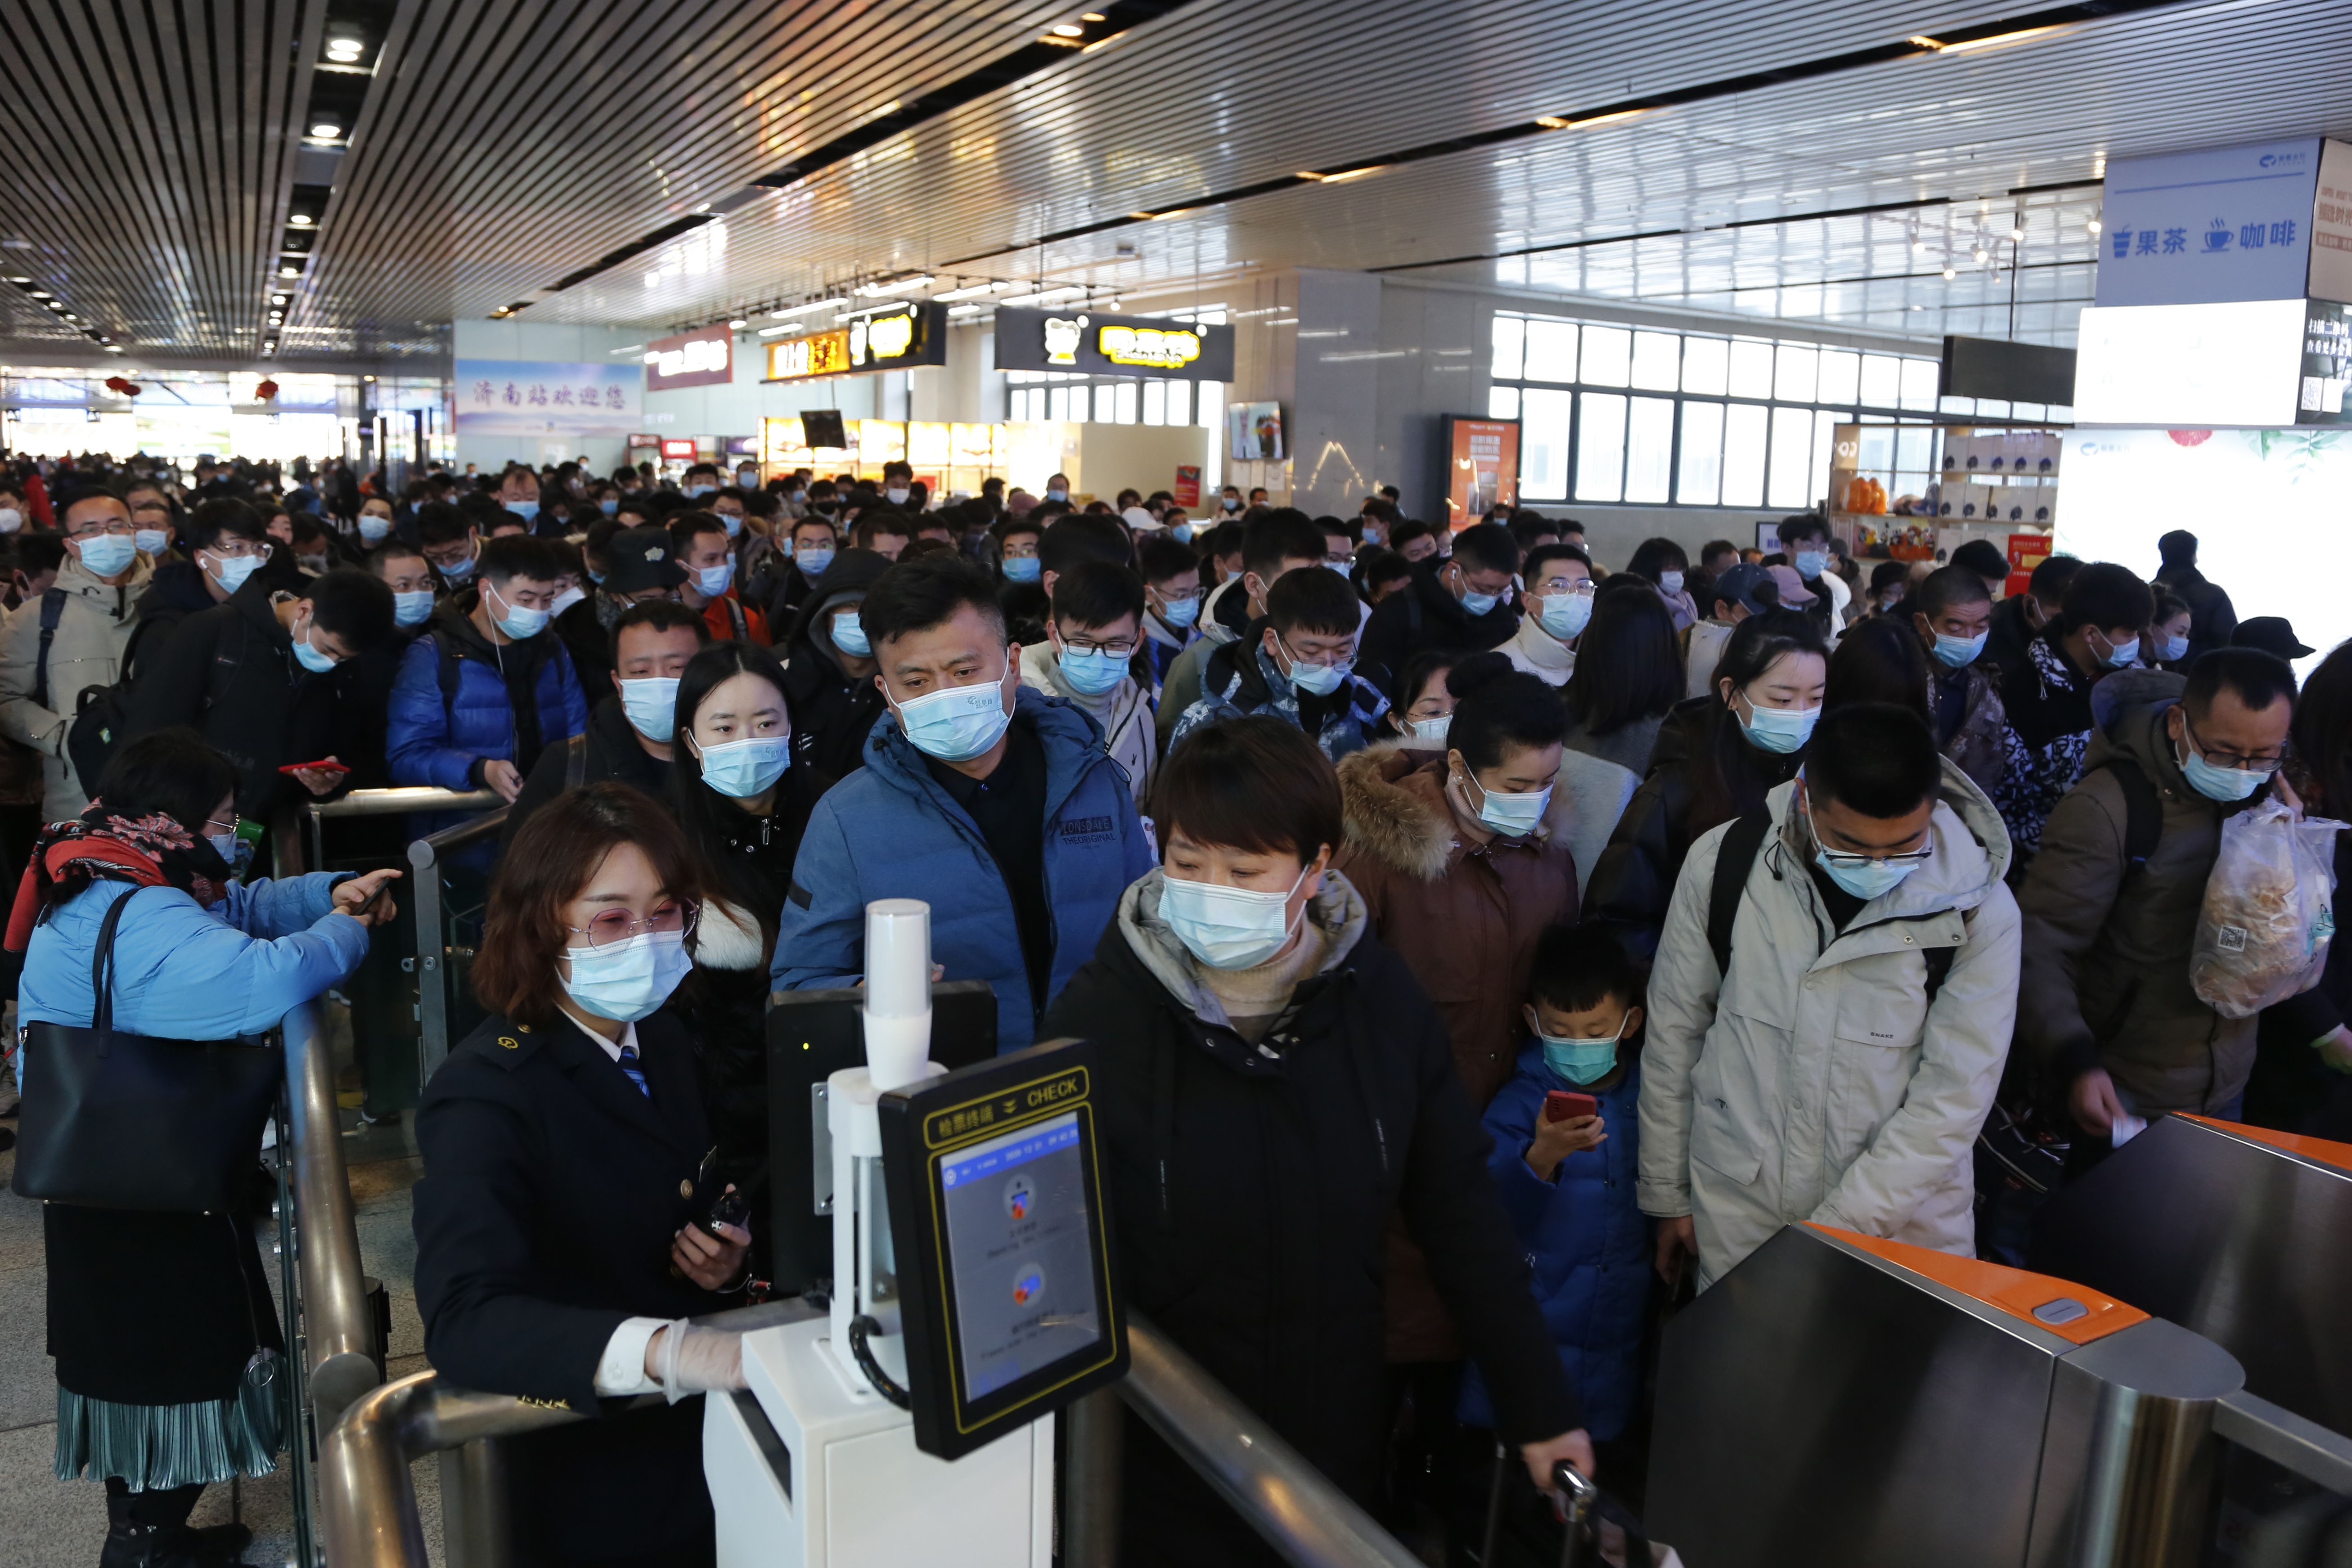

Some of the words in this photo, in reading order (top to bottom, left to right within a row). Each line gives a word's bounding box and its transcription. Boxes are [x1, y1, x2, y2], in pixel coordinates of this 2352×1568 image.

[2135, 228, 2187, 256] 果茶
[2240, 219, 2296, 249] 咖啡
[474, 378, 626, 409] 济南站欢迎您
[1062, 833, 1116, 845] THEORIGINAL
[1063, 818, 1110, 833] LONSDALE
[938, 1103, 994, 1138] 检票终端
[1027, 1077, 1078, 1107] CHECK
